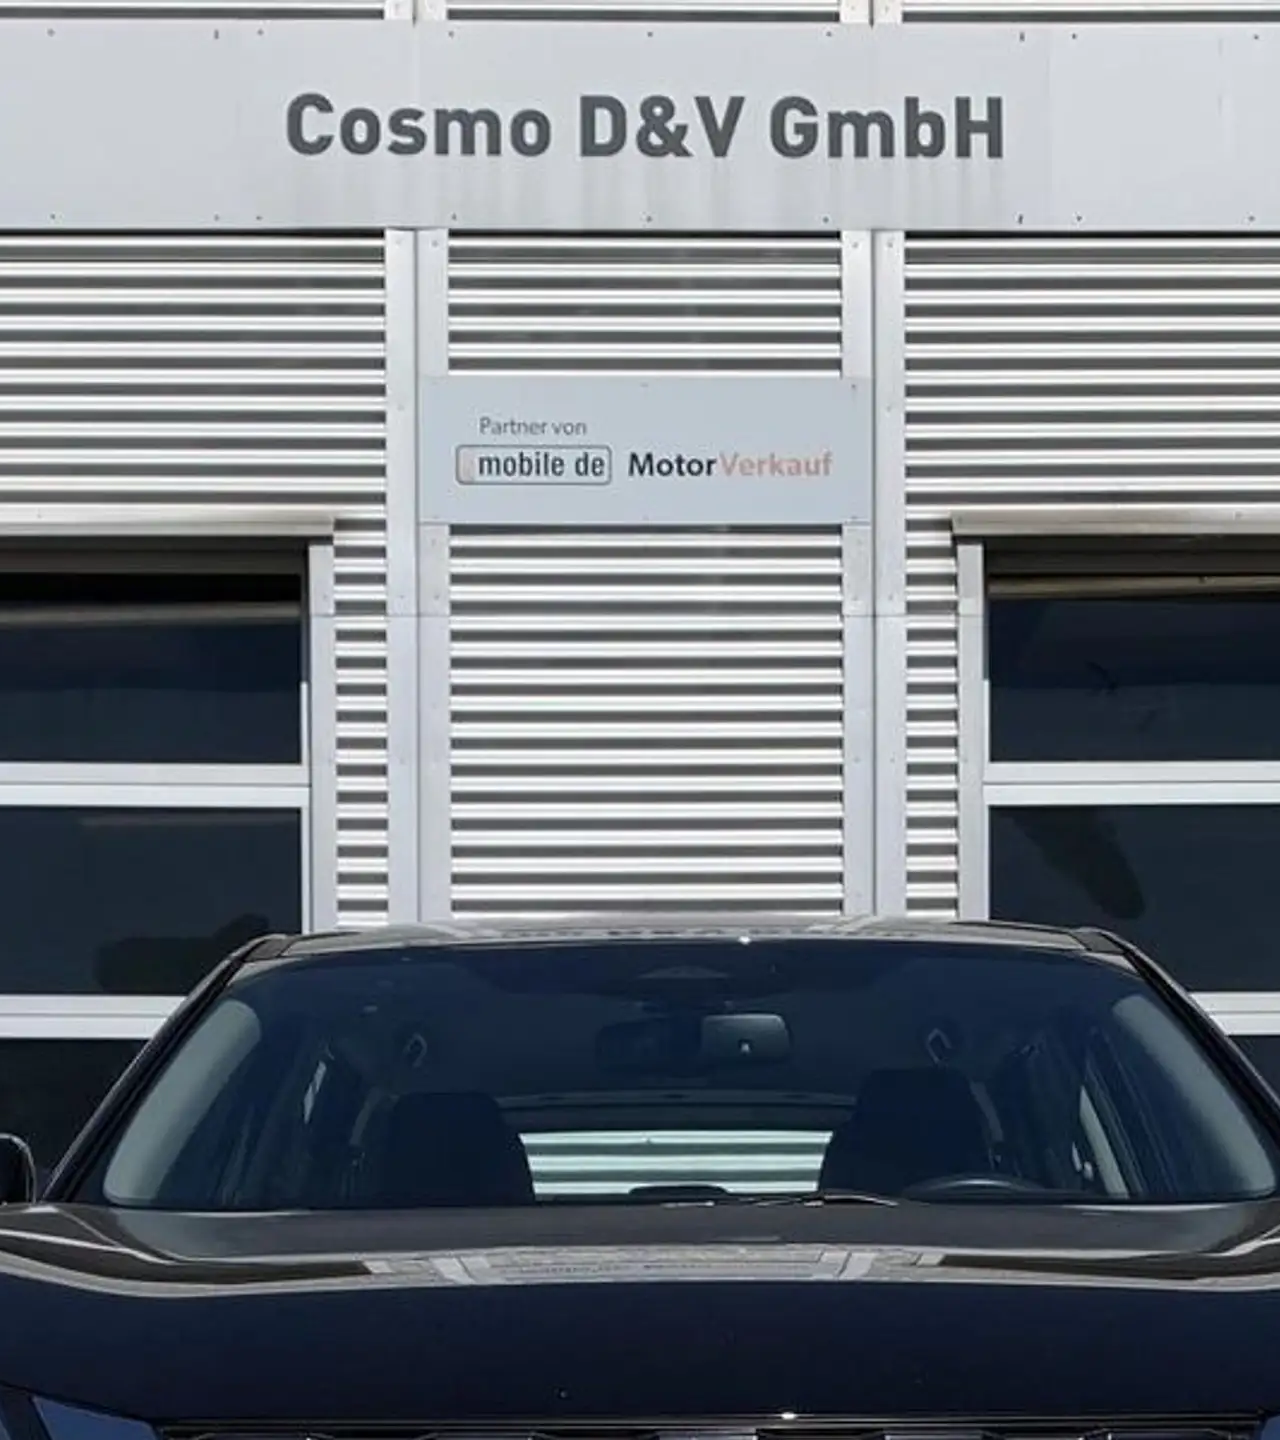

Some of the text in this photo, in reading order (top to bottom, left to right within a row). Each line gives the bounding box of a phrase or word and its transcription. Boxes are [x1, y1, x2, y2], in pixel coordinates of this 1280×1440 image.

[286, 93, 1005, 159] Cosmo D&V GmbH
[478, 416, 587, 436] Partner von
